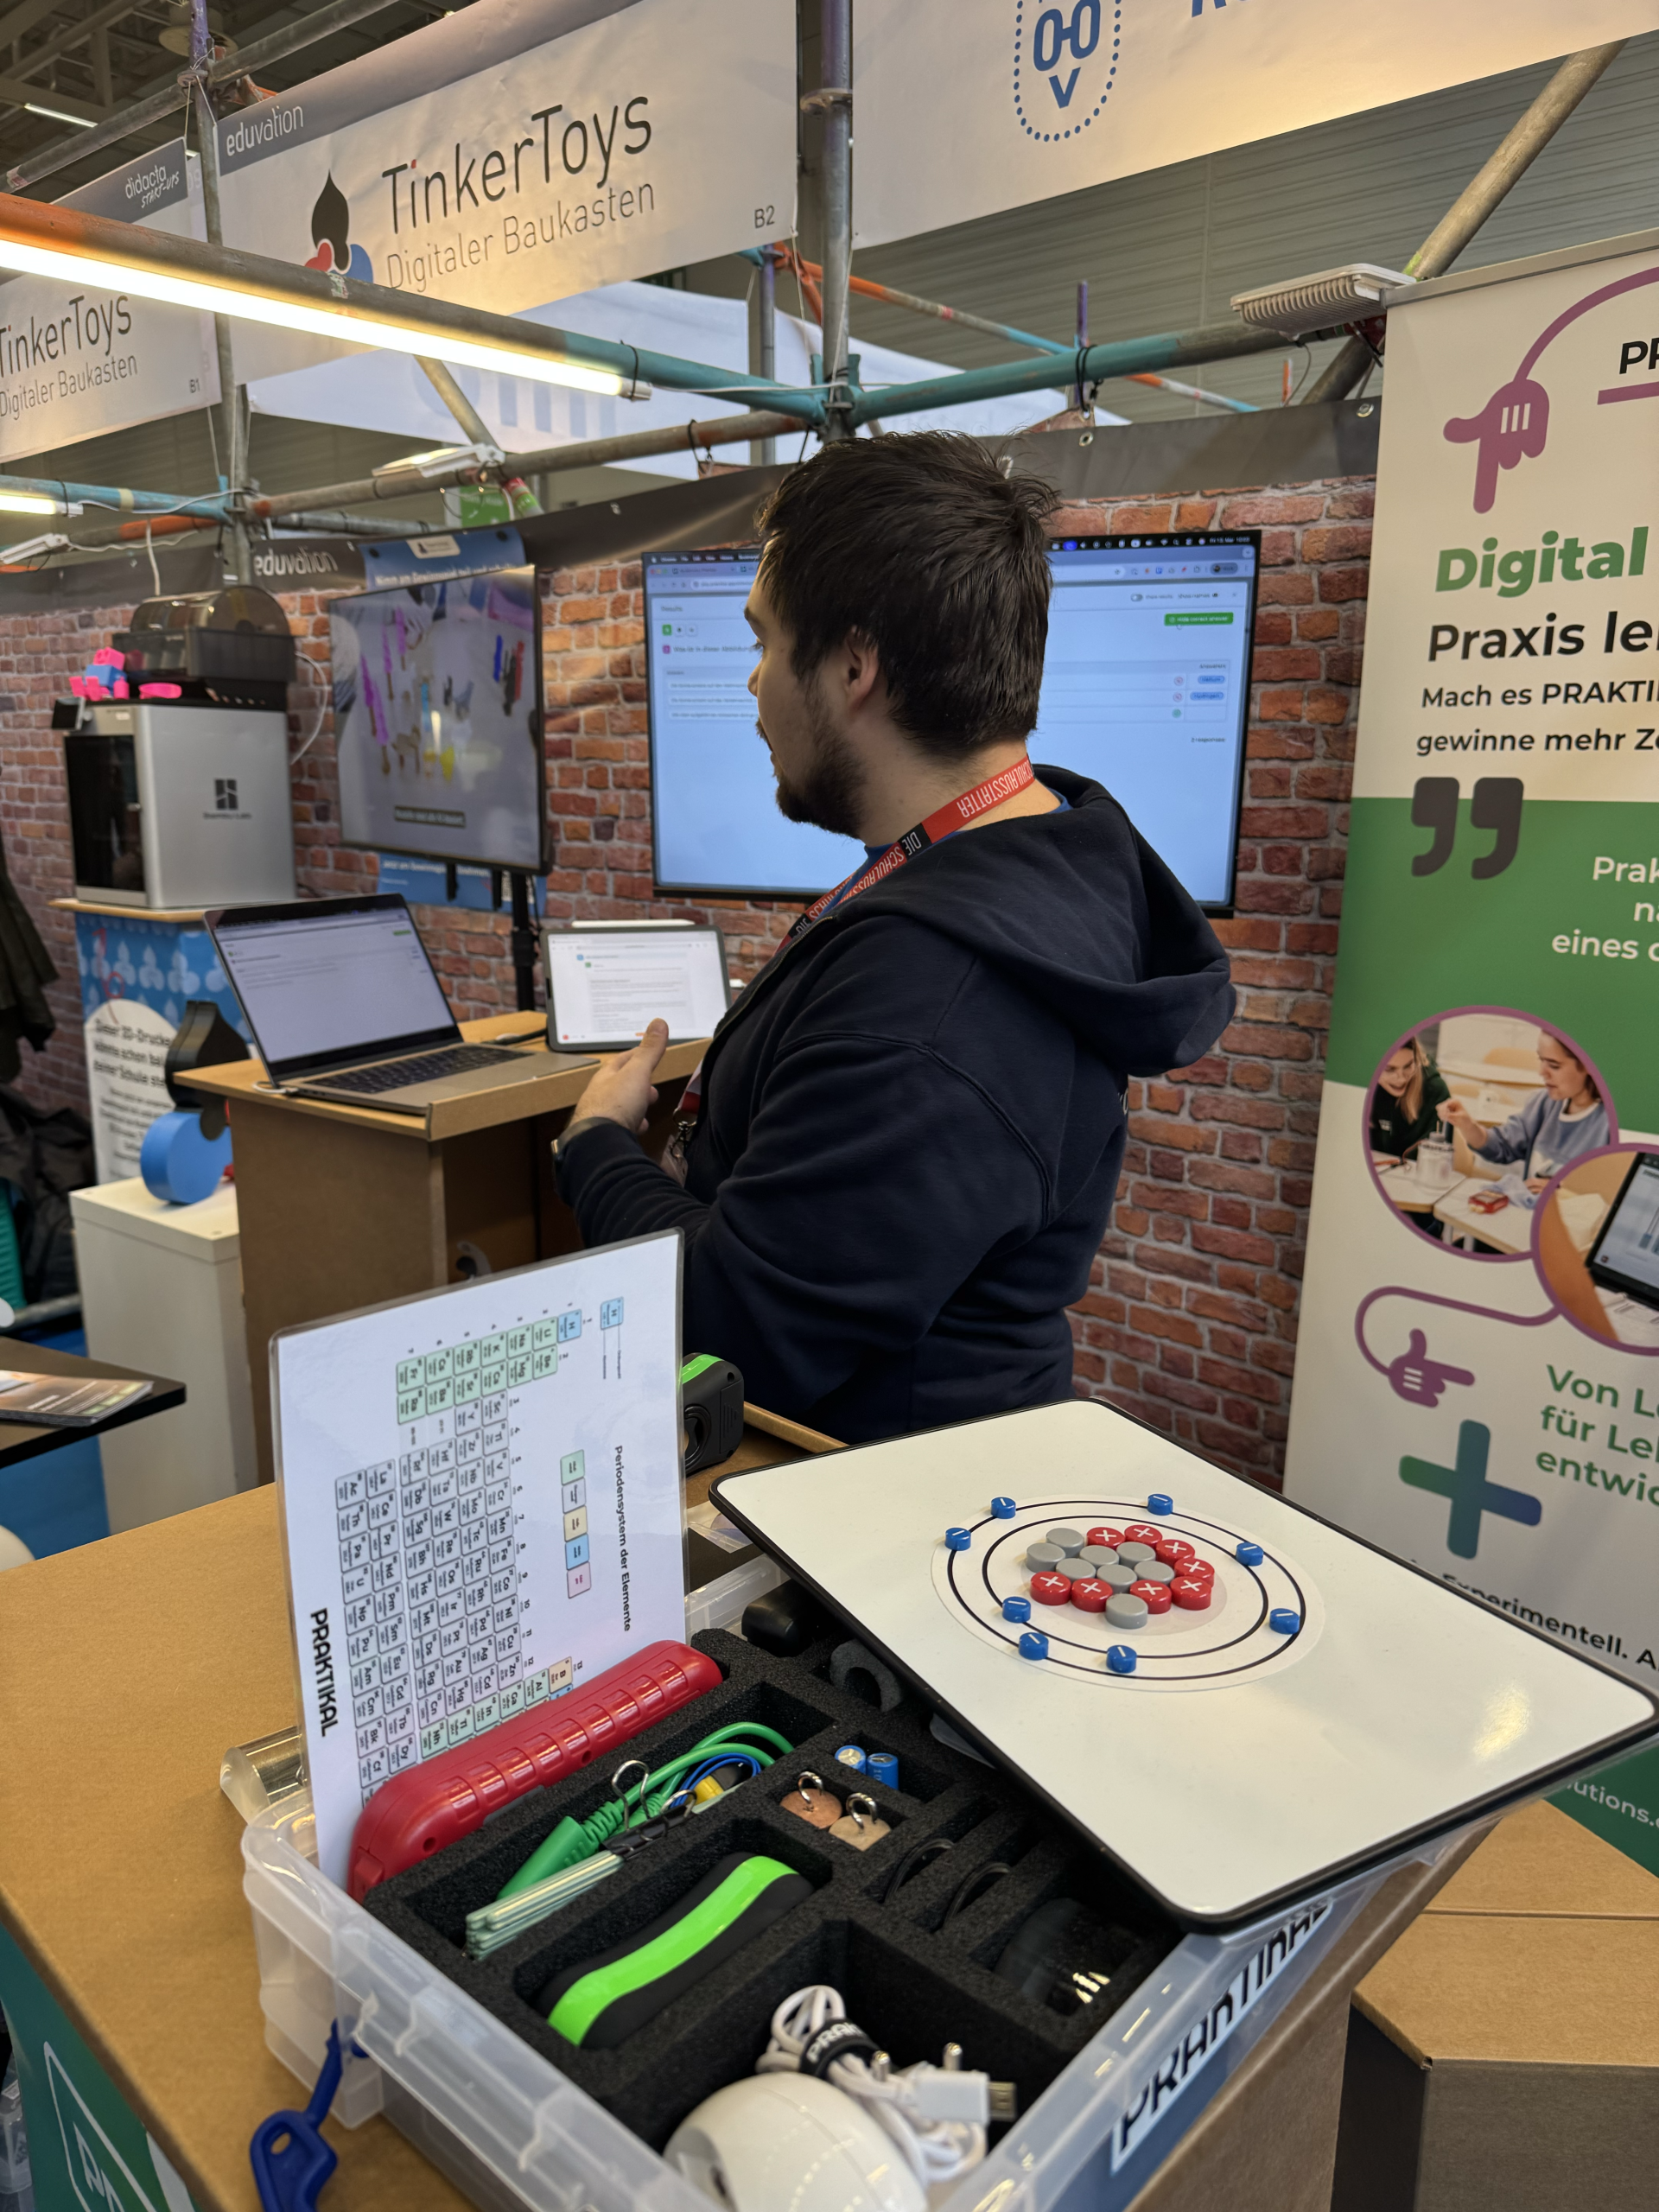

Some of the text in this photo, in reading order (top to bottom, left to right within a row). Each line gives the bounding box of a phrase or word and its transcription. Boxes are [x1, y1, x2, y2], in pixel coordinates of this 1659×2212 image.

[226, 104, 304, 156] eduvation
[125, 164, 167, 200] didacta
[382, 96, 652, 234] TinkerToys
[386, 183, 655, 292] Digitaler Baukasten
[753, 205, 776, 228] B2
[0, 295, 131, 378] TinkerToys
[0, 355, 138, 421] Digitaler Baukasten
[189, 378, 200, 393] B1
[1434, 526, 1649, 598] Digital
[1427, 610, 1659, 663] Praxis le
[1421, 680, 1659, 708] Mach es PRAKTI
[1416, 728, 1535, 757] gewinne
[1544, 728, 1626, 751] mehr
[900, 831, 922, 856] DIE
[1552, 928, 1639, 960] eines
[1546, 1363, 1659, 1419] Von L
[1540, 1404, 1659, 1464] für Le
[614, 1446, 631, 1632] Periodensystem der Elemente
[310, 1608, 338, 1737] PRAKTIKAL
[1636, 1649, 1659, 1671] A
[1567, 1782, 1659, 1829] utions.
